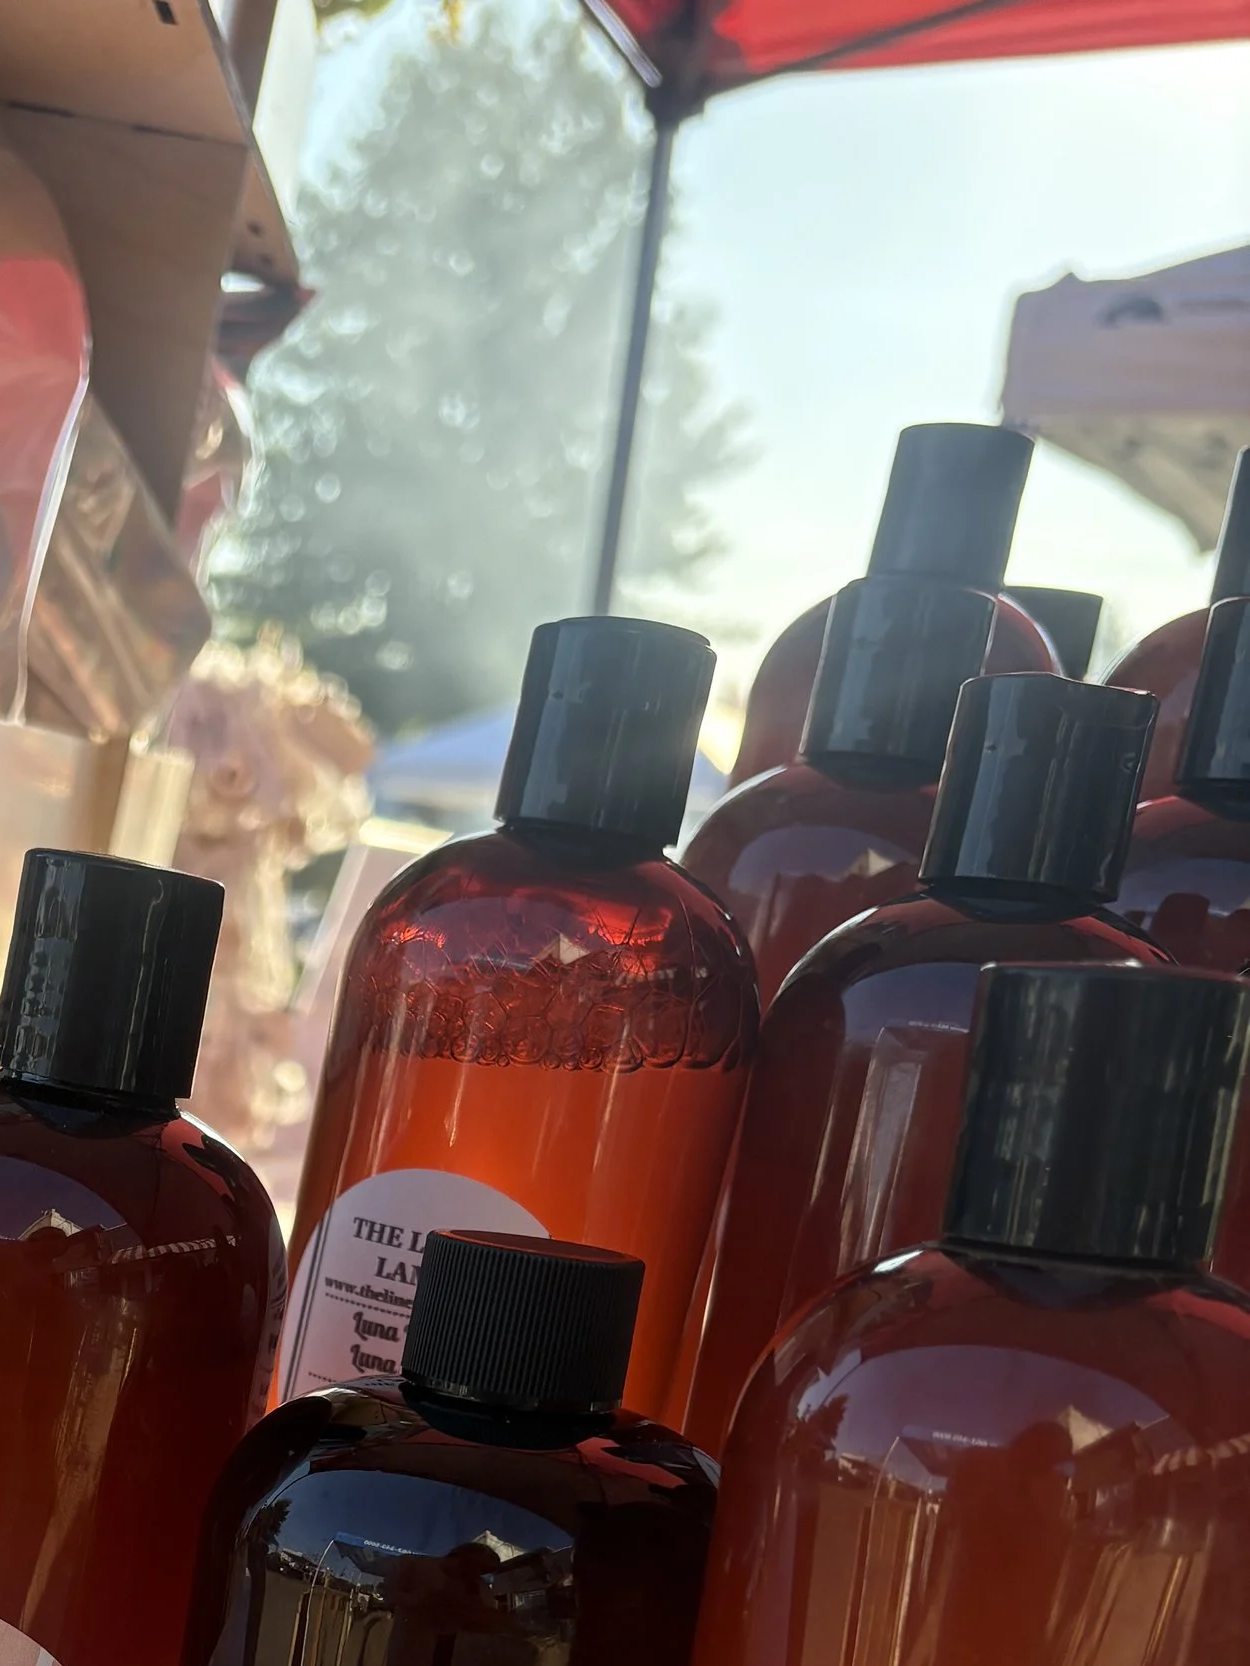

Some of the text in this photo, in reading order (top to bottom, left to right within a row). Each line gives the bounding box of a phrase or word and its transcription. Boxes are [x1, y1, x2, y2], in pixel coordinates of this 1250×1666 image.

[353, 1216, 405, 1249] THE
[375, 1256, 422, 1286] LA
[352, 1311, 400, 1343] Luna
[350, 1343, 398, 1375] Luna
